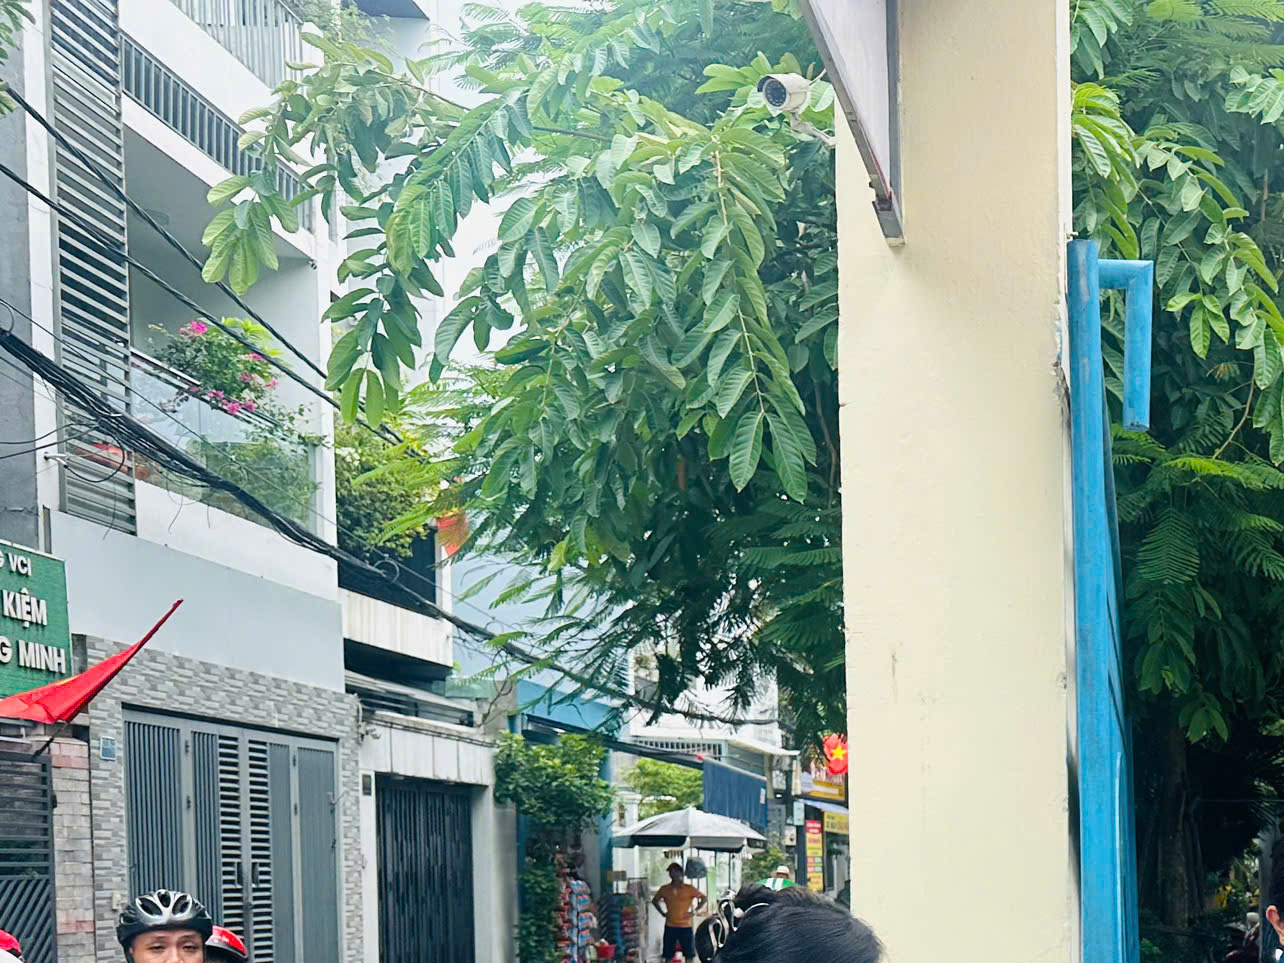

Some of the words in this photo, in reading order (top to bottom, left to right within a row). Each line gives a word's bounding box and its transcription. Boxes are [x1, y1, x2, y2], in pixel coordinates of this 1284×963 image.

[8, 552, 32, 576] VCI
[2, 587, 48, 628] KIỆM
[18, 640, 66, 674] MINH
